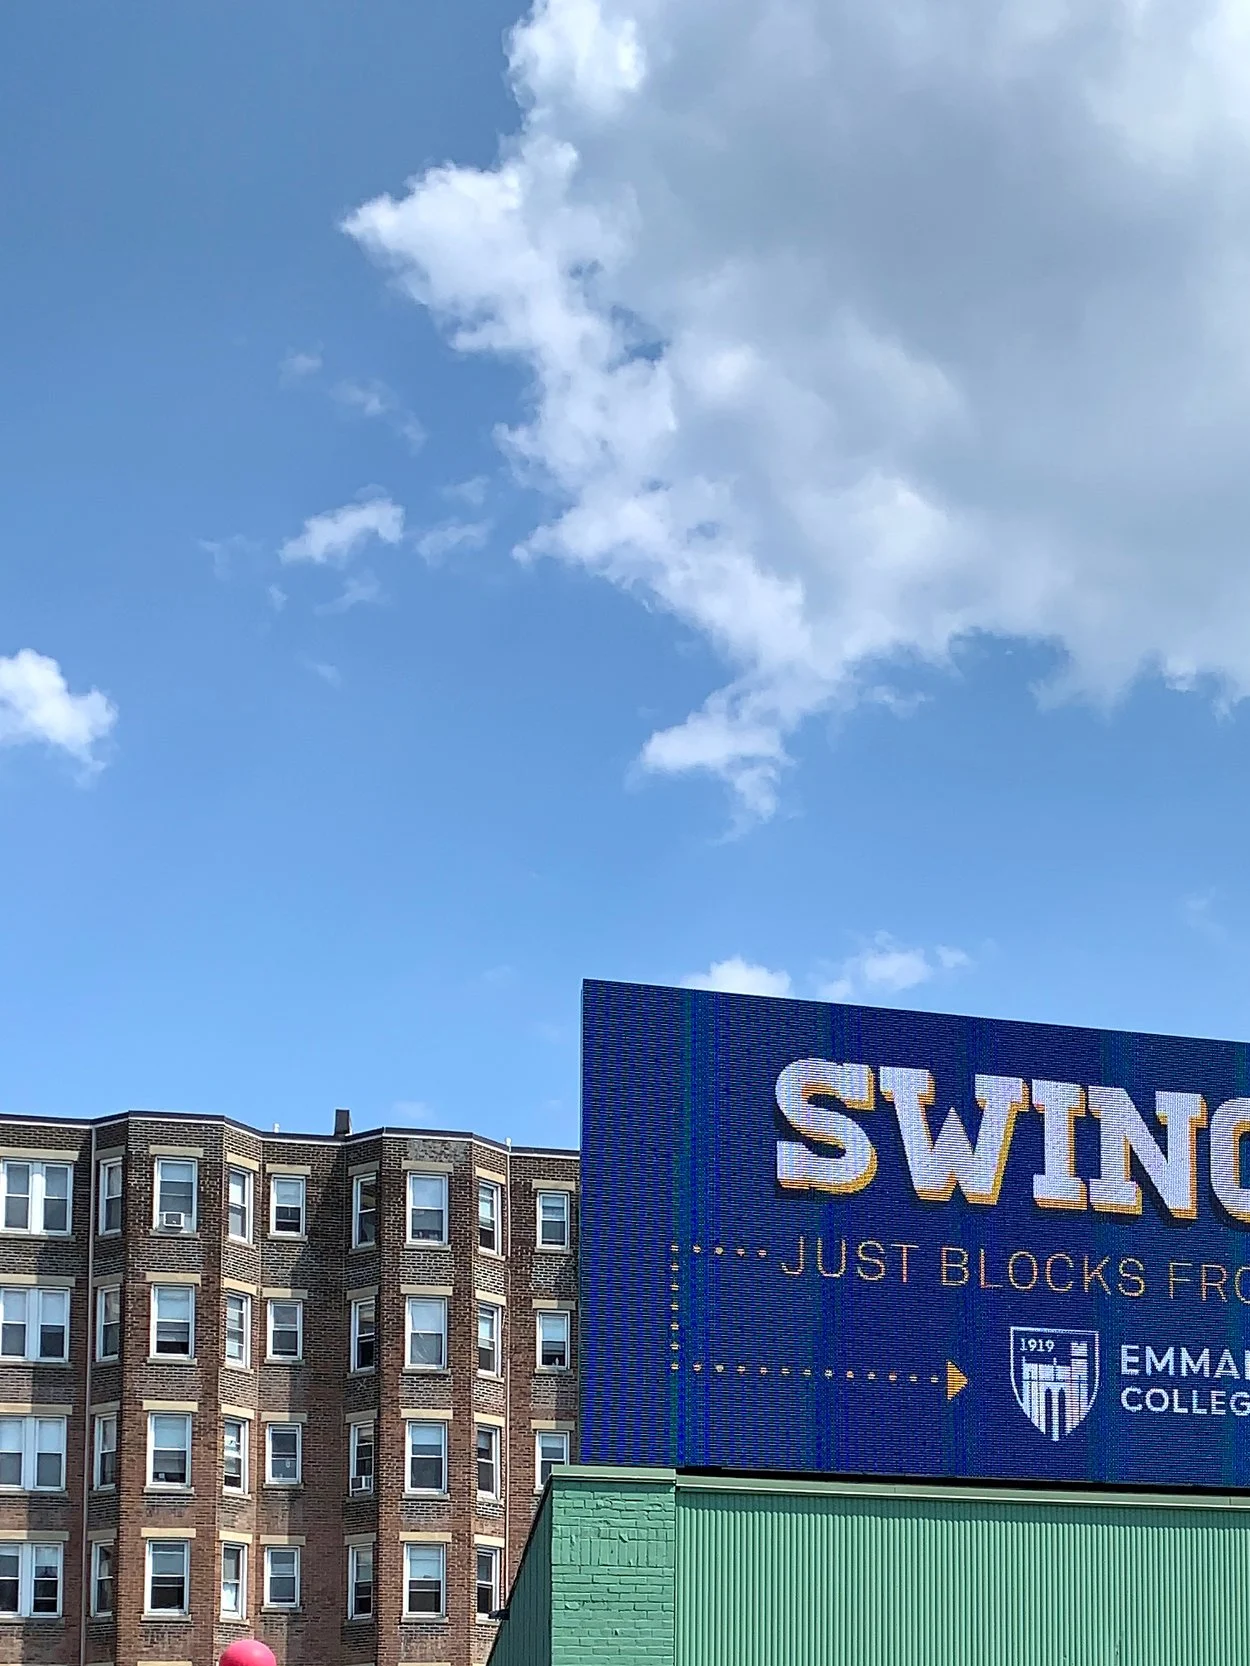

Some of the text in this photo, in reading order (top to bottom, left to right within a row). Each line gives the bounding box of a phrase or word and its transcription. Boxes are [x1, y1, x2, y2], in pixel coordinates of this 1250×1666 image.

[780, 1237, 919, 1284] JUST
[940, 1246, 1146, 1297] BLOCKS
[1020, 1337, 1055, 1353] 1919
